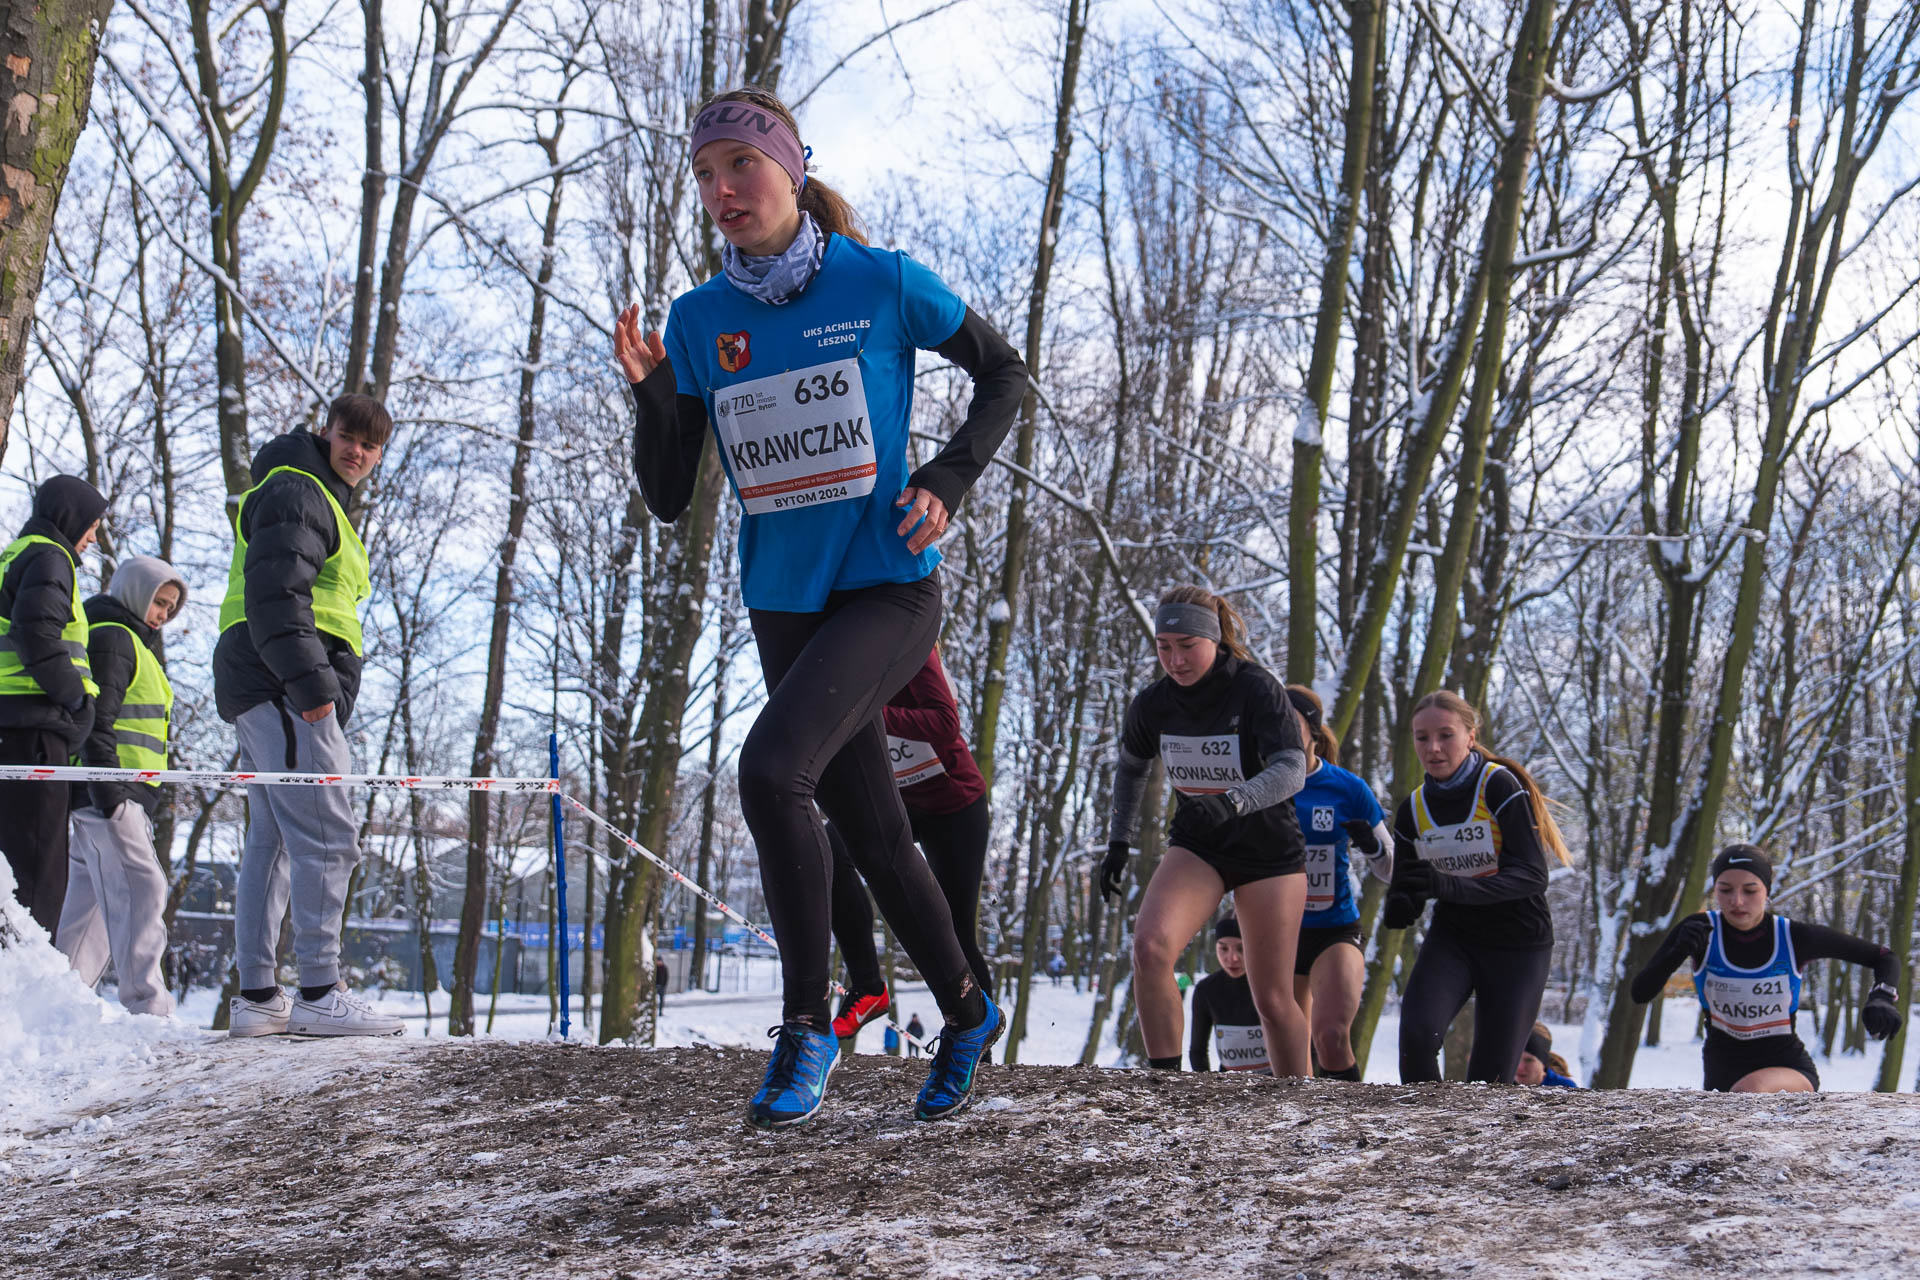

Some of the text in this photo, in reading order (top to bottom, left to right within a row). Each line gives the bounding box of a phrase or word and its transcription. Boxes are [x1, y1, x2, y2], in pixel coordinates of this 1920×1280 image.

[694, 106, 777, 136] RUN
[803, 319, 871, 338] UKS ACHILLES
[818, 333, 857, 347] LESZNO
[795, 370, 849, 405] 636
[731, 394, 755, 410] 770
[730, 417, 869, 472] KRAWCZAK
[774, 486, 848, 508] BYTOM 2024
[1201, 741, 1232, 755] 632
[1166, 766, 1242, 782] KOWALSKA
[1454, 826, 1485, 842] 433
[1305, 849, 1327, 862] 75
[1752, 980, 1783, 995] 621
[1713, 999, 1782, 1019] ŁAŃSKA
